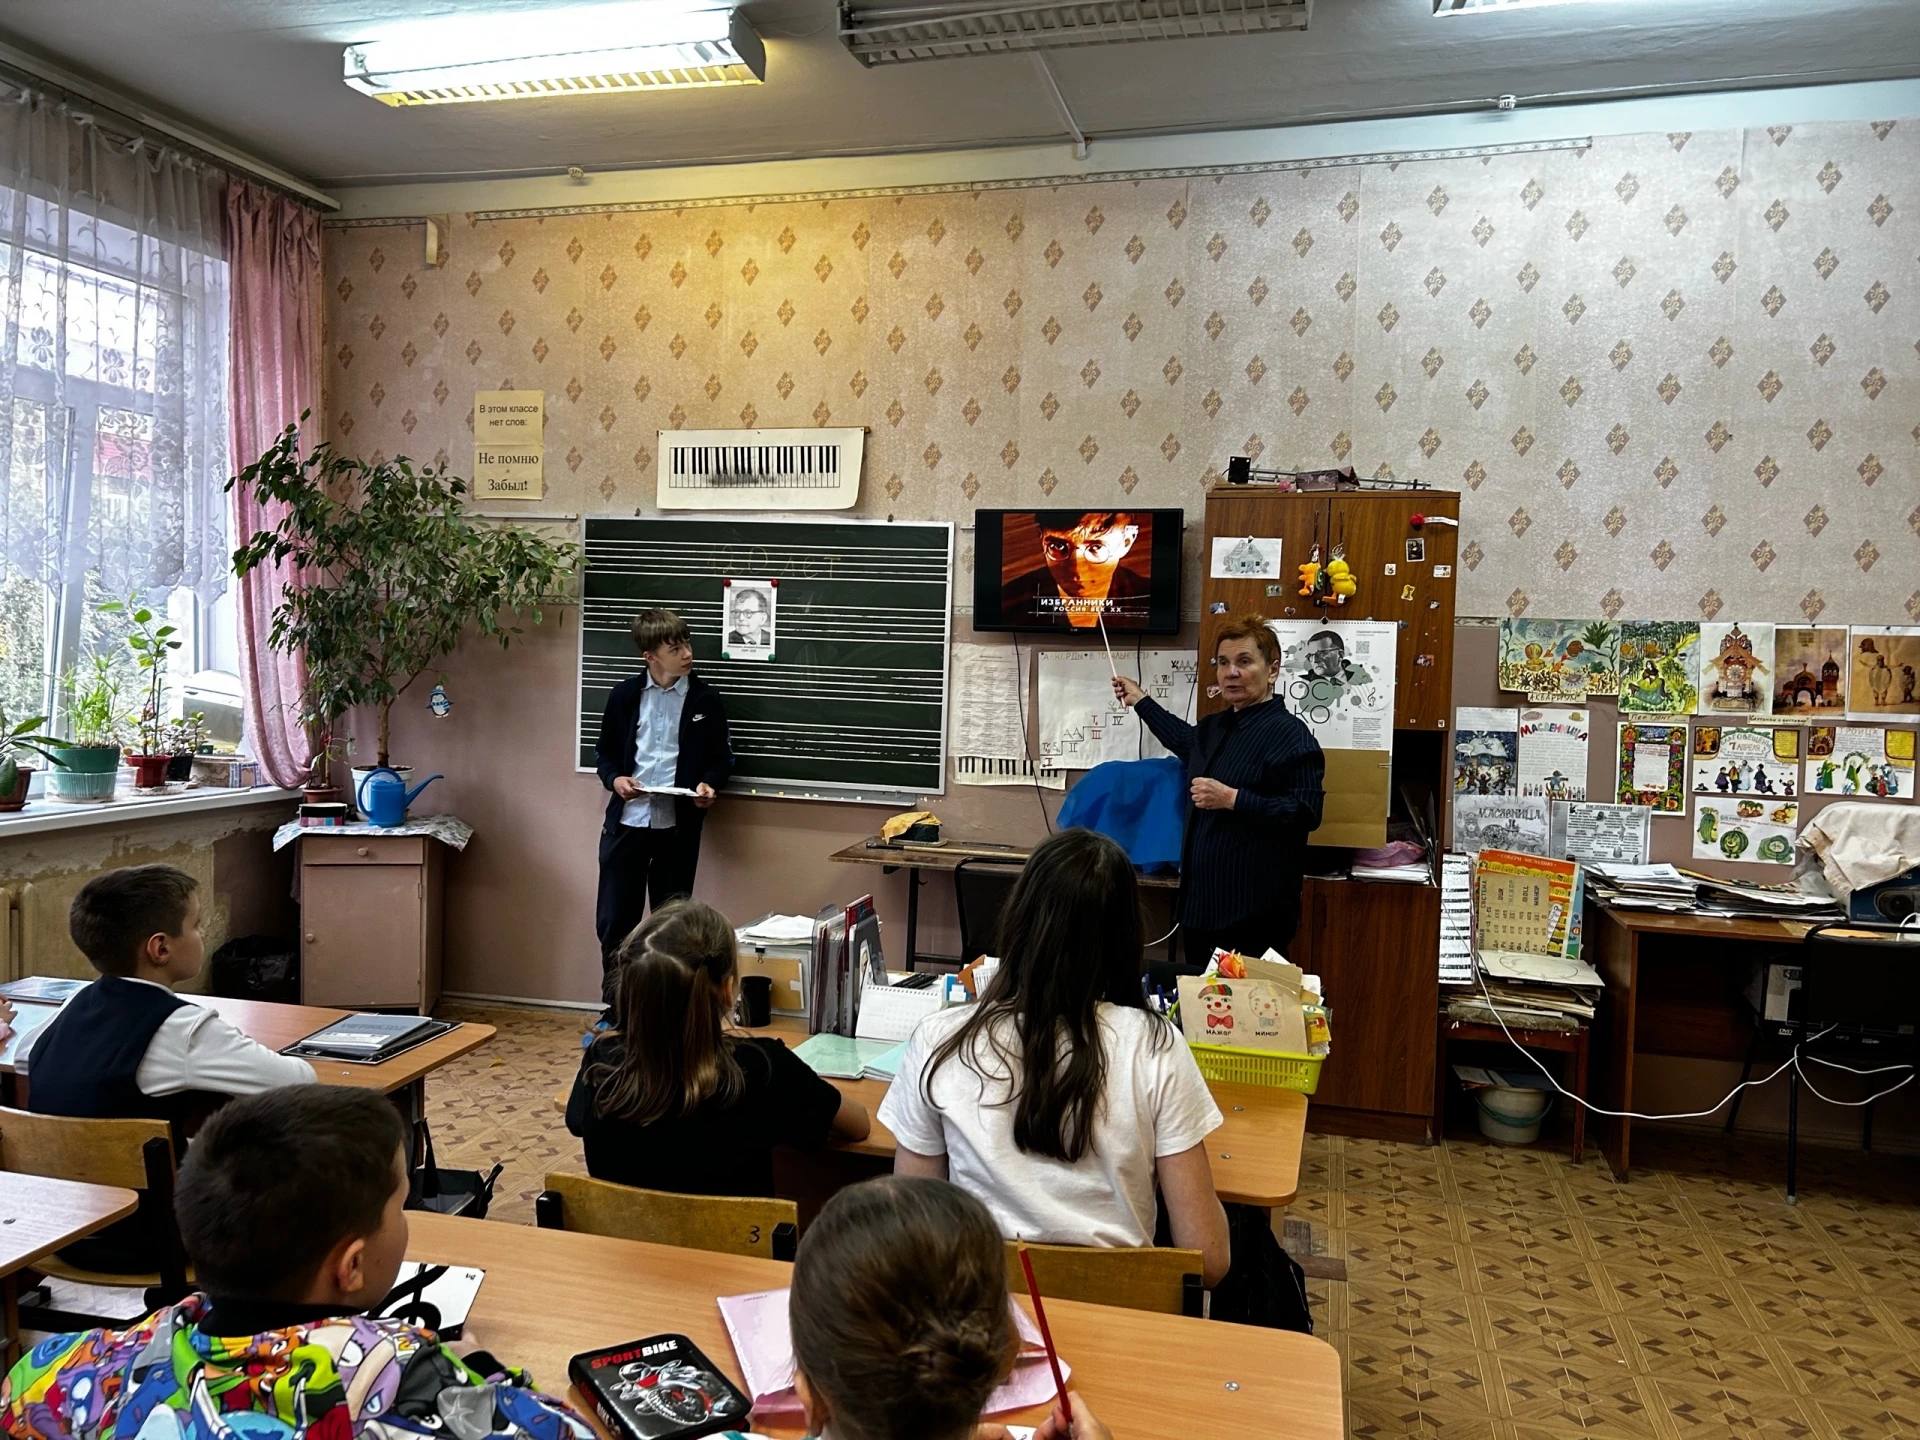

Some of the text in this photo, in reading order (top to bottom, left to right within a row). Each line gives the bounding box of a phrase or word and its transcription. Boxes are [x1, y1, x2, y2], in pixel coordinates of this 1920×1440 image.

[480, 405, 538, 413] В этом классе
[478, 453, 539, 465] Не помню
[488, 478, 528, 491] Забыл!
[1040, 598, 1114, 607] ИЗБРАННИКИ
[1156, 687, 1169, 698] VI
[1112, 716, 1124, 725] IV
[1091, 730, 1102, 739] III
[1069, 743, 1078, 752] II
[1729, 741, 1761, 751] 7 АПРЕЛЯ
[749, 1224, 760, 1244] 3
